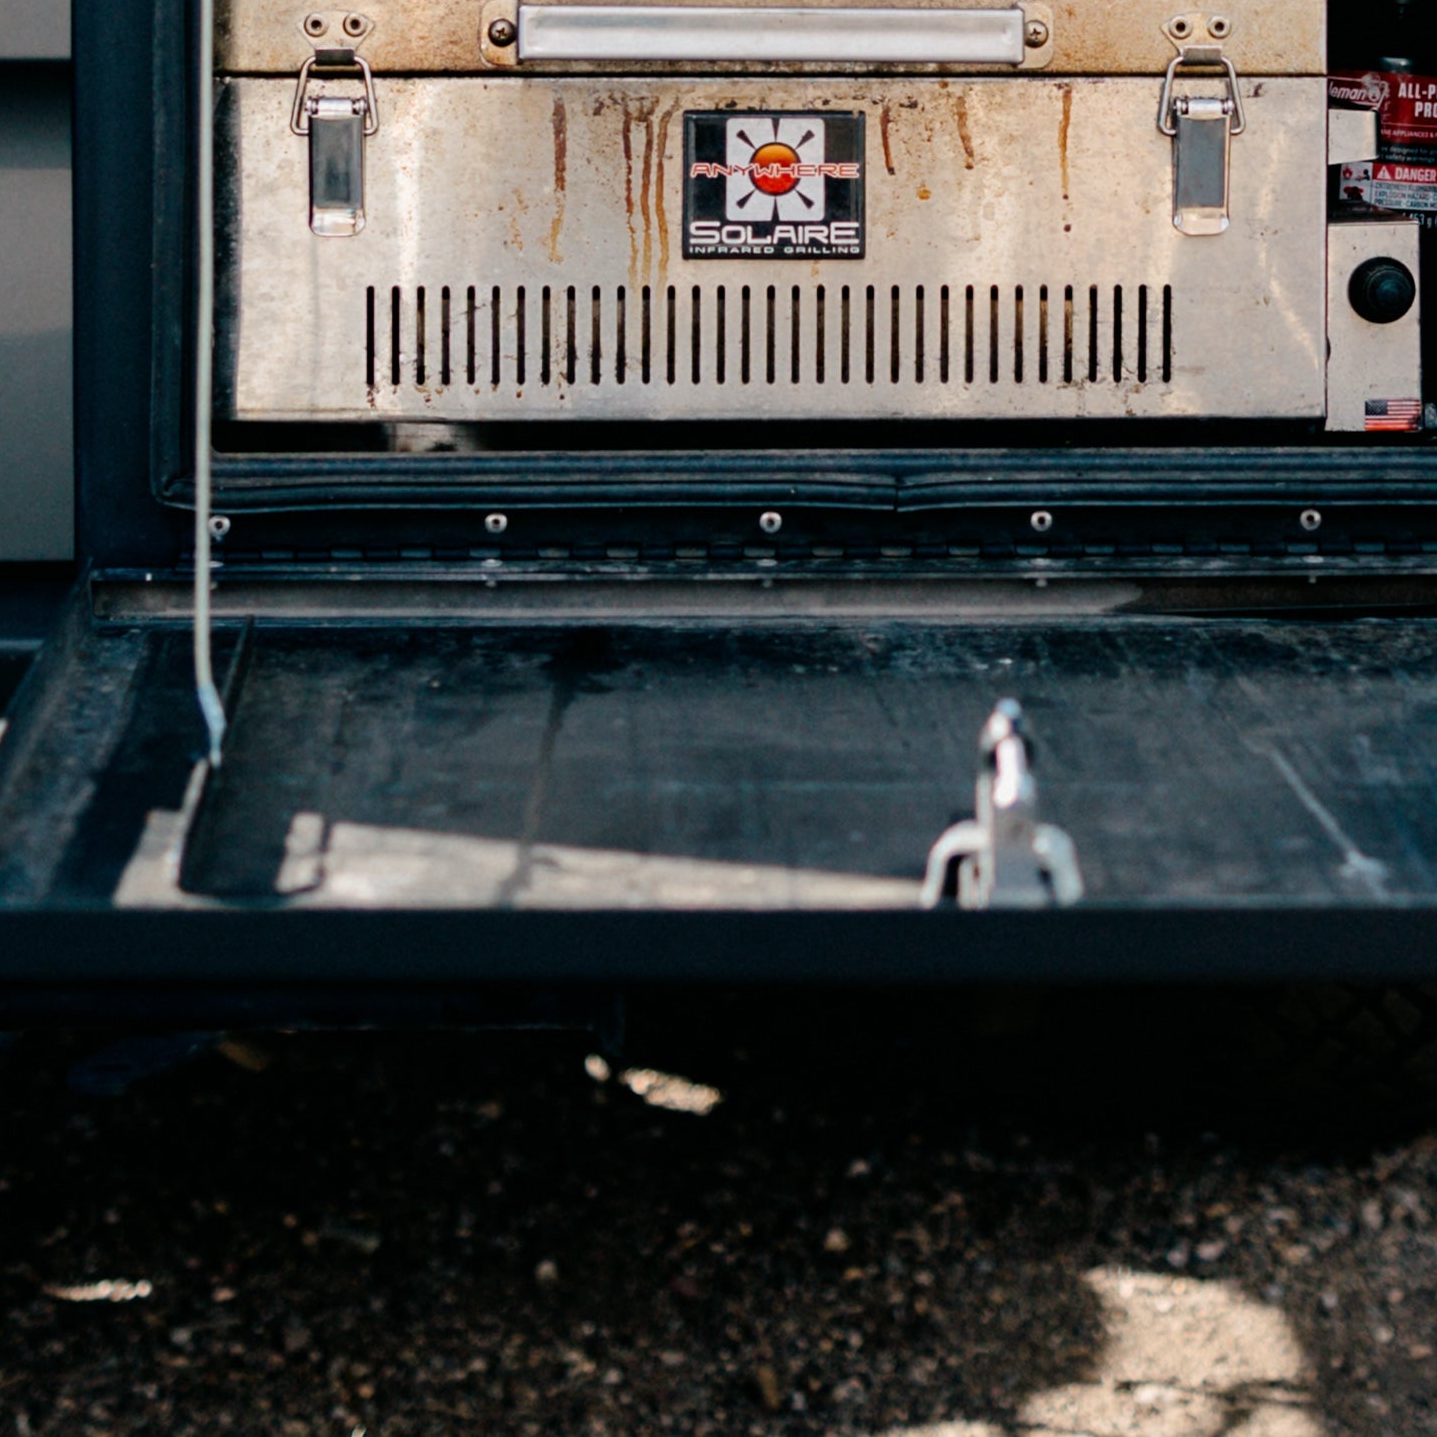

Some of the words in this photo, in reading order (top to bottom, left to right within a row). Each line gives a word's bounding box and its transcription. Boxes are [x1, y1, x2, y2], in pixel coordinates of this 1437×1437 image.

[1328, 80, 1367, 100] leman
[689, 162, 860, 179] ANYWHERE
[1394, 167, 1437, 182] DANGER
[689, 220, 860, 245] SOLAIRE
[689, 246, 775, 254] INFRARED
[783, 246, 860, 254] GRILLING
